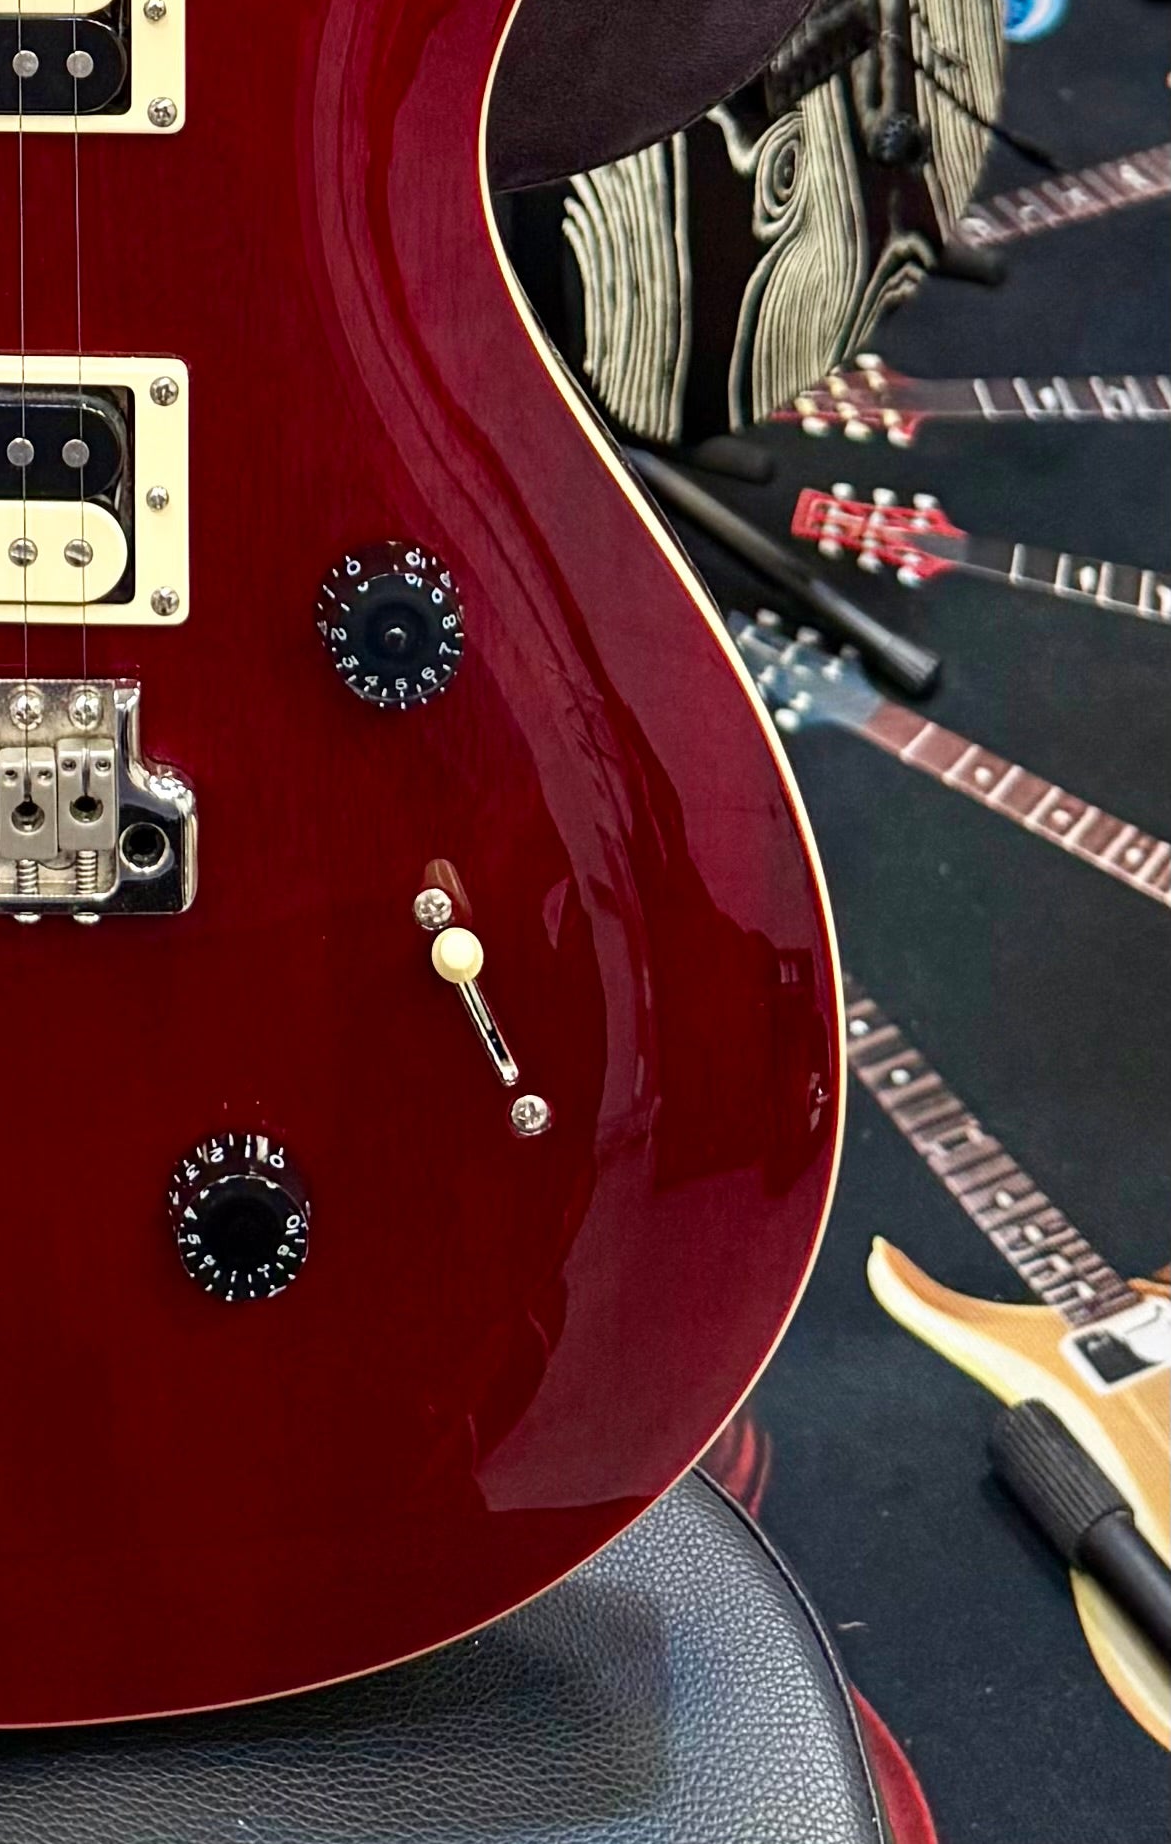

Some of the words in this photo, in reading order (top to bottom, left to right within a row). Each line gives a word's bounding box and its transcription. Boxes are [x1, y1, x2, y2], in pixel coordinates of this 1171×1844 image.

[330, 626, 348, 642] 2
[341, 654, 360, 669] 3
[394, 677, 408, 691] 5
